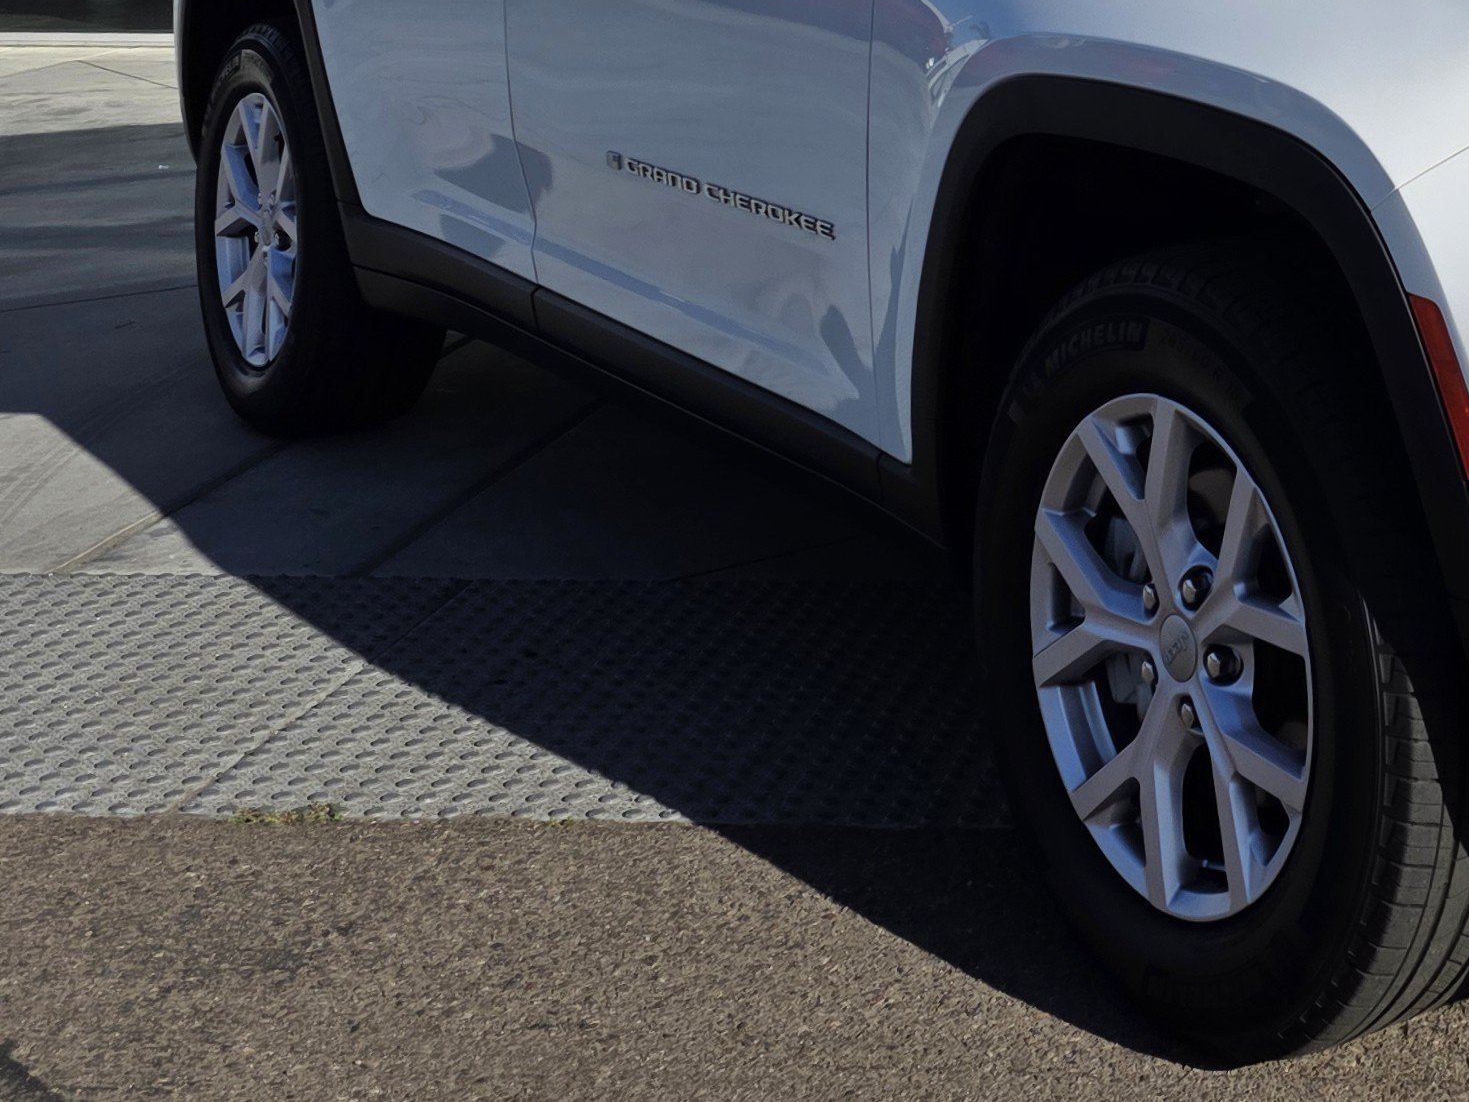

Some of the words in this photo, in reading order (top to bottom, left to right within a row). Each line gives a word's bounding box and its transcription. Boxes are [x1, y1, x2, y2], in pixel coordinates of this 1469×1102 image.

[622, 156, 701, 195] GRAND
[702, 182, 837, 241] CHEROKEE
[1044, 320, 1143, 377] MICHELIN
